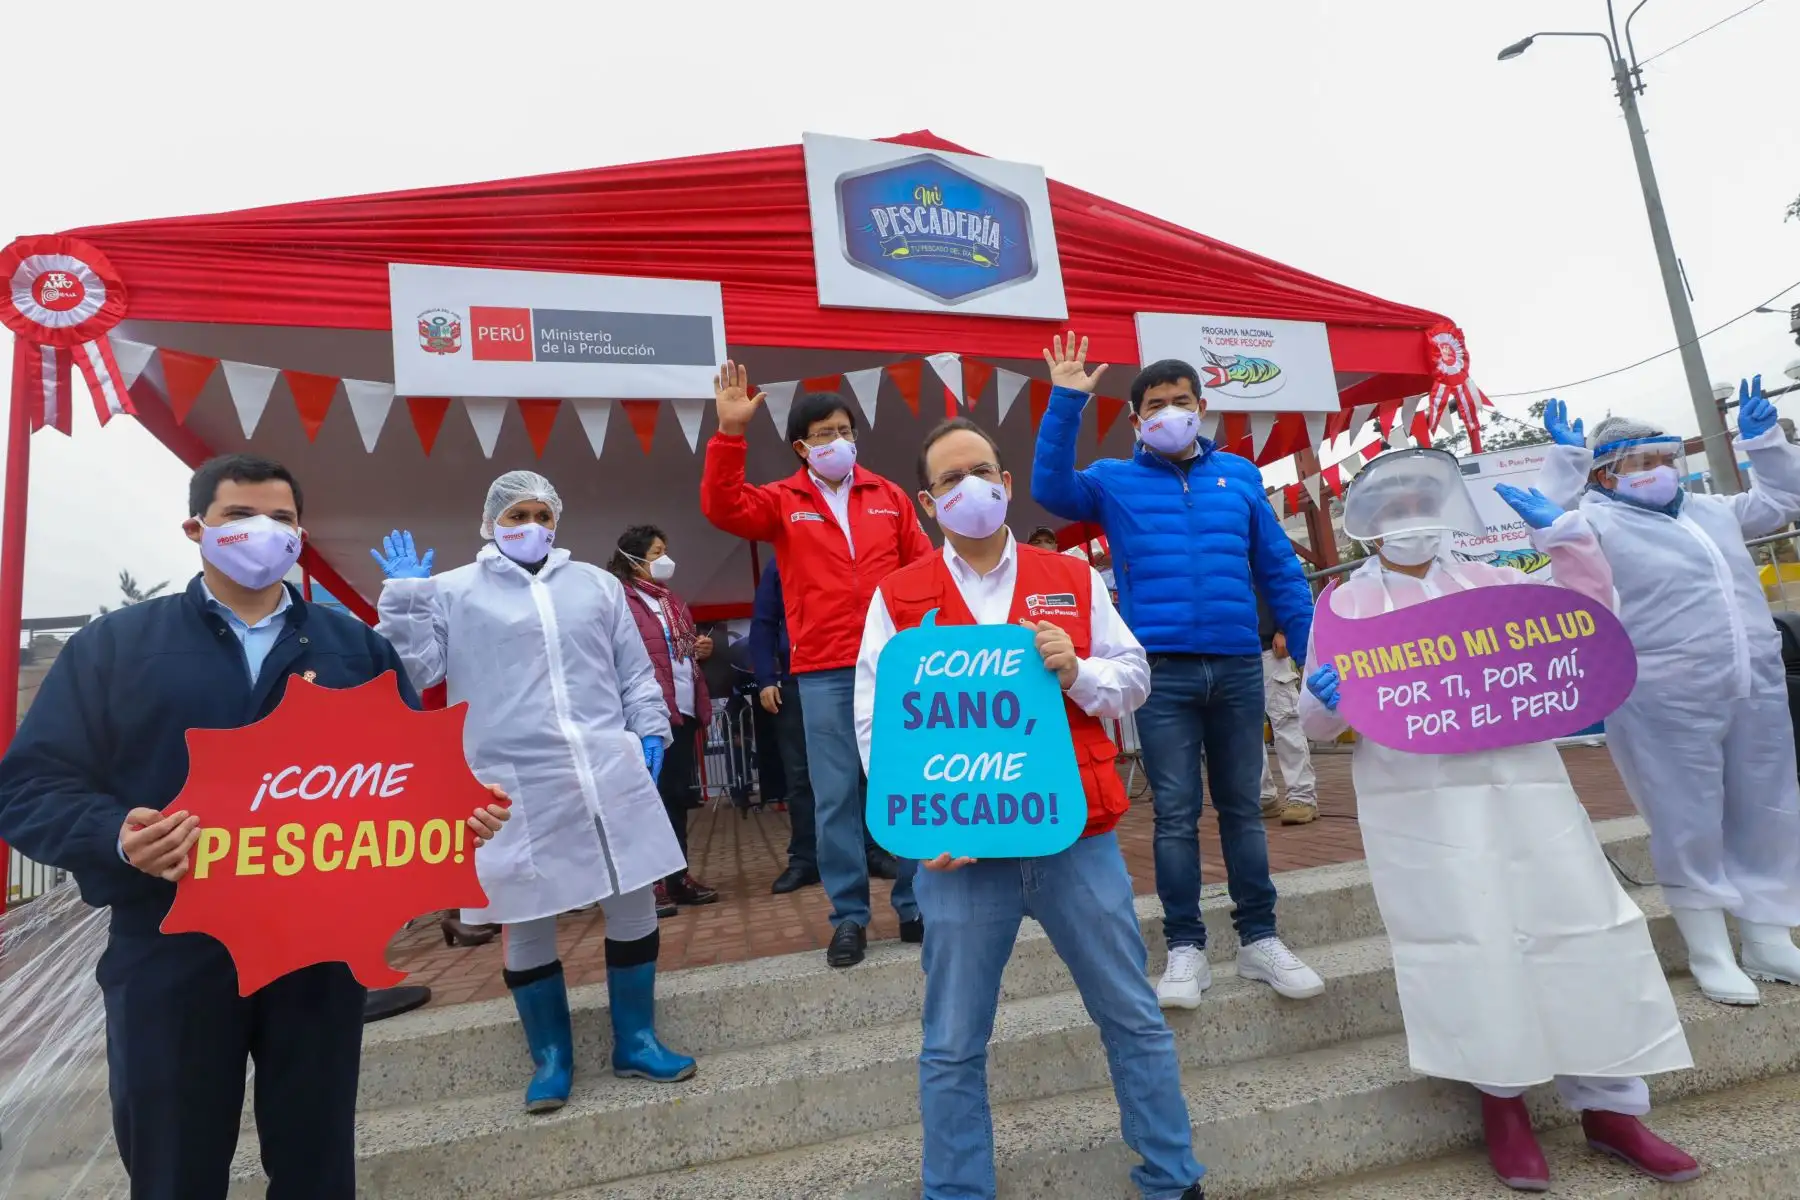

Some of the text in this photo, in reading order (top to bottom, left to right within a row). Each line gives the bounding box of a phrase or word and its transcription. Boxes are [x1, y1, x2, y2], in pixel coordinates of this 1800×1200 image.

[915, 186, 943, 206] Mi
[870, 206, 1000, 249] PESCADERÍA
[48, 273, 66, 281] TE
[478, 324, 525, 342] PERÚ
[541, 328, 612, 342] Ministerio
[1201, 326, 1274, 338] PROGRAMA NACIONAL
[1216, 337, 1240, 346] COMER
[541, 342, 656, 356] de la Producción
[943, 492, 963, 511] PRODUCE
[217, 532, 249, 544] PRODUCE
[1469, 534, 1498, 546] COMER
[1333, 609, 1596, 681] PRIMERO MI SALUD
[913, 648, 1027, 685] ¡COME
[1377, 647, 1585, 711] POR TI, POR MÍ,
[902, 690, 1038, 735] SANO,
[1406, 681, 1580, 739] POR EL PERÚ
[923, 751, 1028, 782] COME
[249, 762, 414, 812] ¡COME
[887, 791, 1060, 826] PESCADO!
[193, 818, 466, 880] PESCADO!
